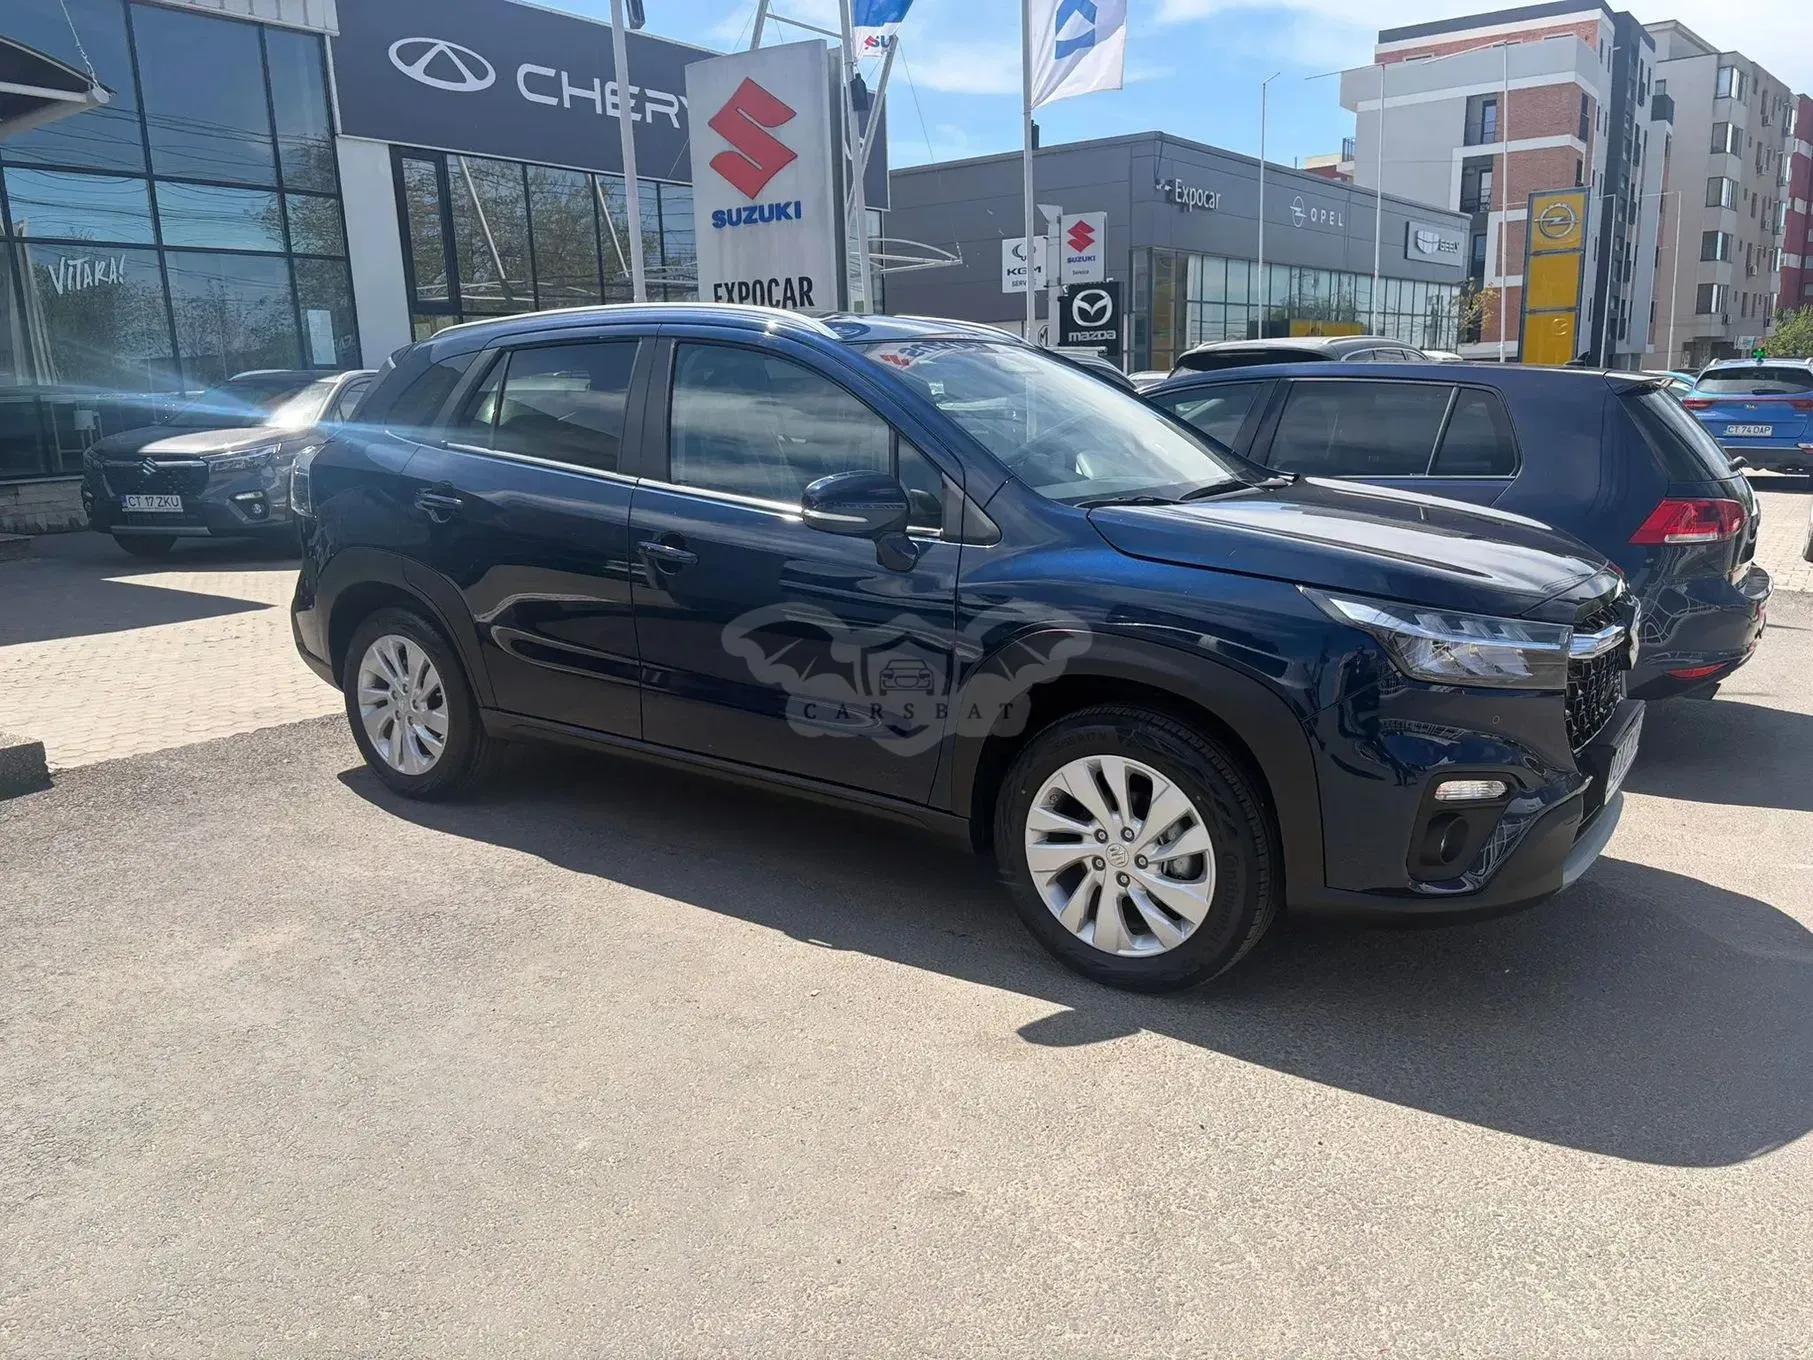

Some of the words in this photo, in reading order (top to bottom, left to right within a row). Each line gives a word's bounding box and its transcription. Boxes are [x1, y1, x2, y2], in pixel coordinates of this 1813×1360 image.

[1174, 178, 1222, 212] Expocar
[711, 200, 802, 229] SUZUKI
[1310, 207, 1344, 227] OPEL
[1067, 255, 1096, 264] SUZUKI
[713, 276, 815, 309] EXPOCAR
[1727, 425, 1739, 434] CT
[1741, 425, 1752, 434] 74
[128, 496, 141, 507] CT
[145, 497, 154, 507] 17
[155, 497, 179, 508] ZKU
